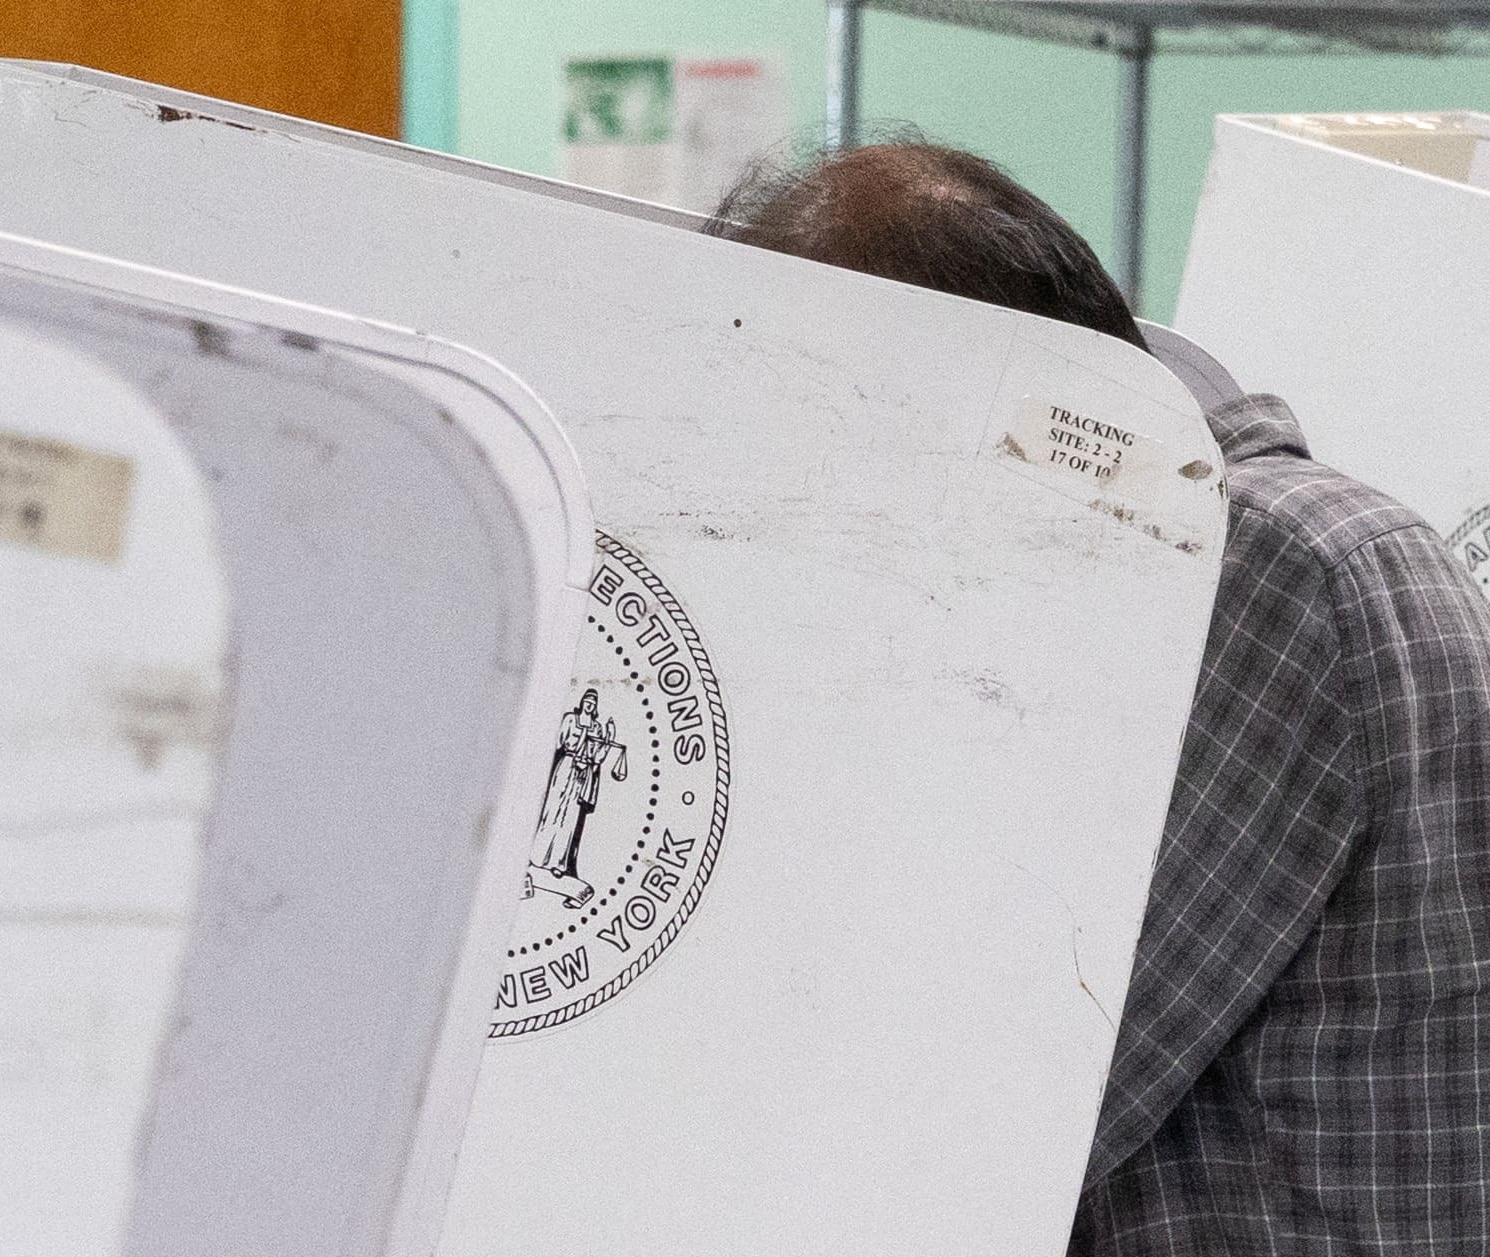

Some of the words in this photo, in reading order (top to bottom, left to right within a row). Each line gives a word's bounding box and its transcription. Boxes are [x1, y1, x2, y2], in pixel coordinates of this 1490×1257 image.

[1048, 427, 1090, 452] SITE:
[1092, 443, 1102, 456] 2
[1113, 450, 1122, 464] 2
[1050, 406, 1135, 447] TRACKING
[1050, 449, 1067, 464] 17
[1069, 456, 1092, 472] OF
[589, 565, 705, 765] ECTIONS
[493, 946, 591, 1010] NEW
[597, 828, 695, 954] YORK
